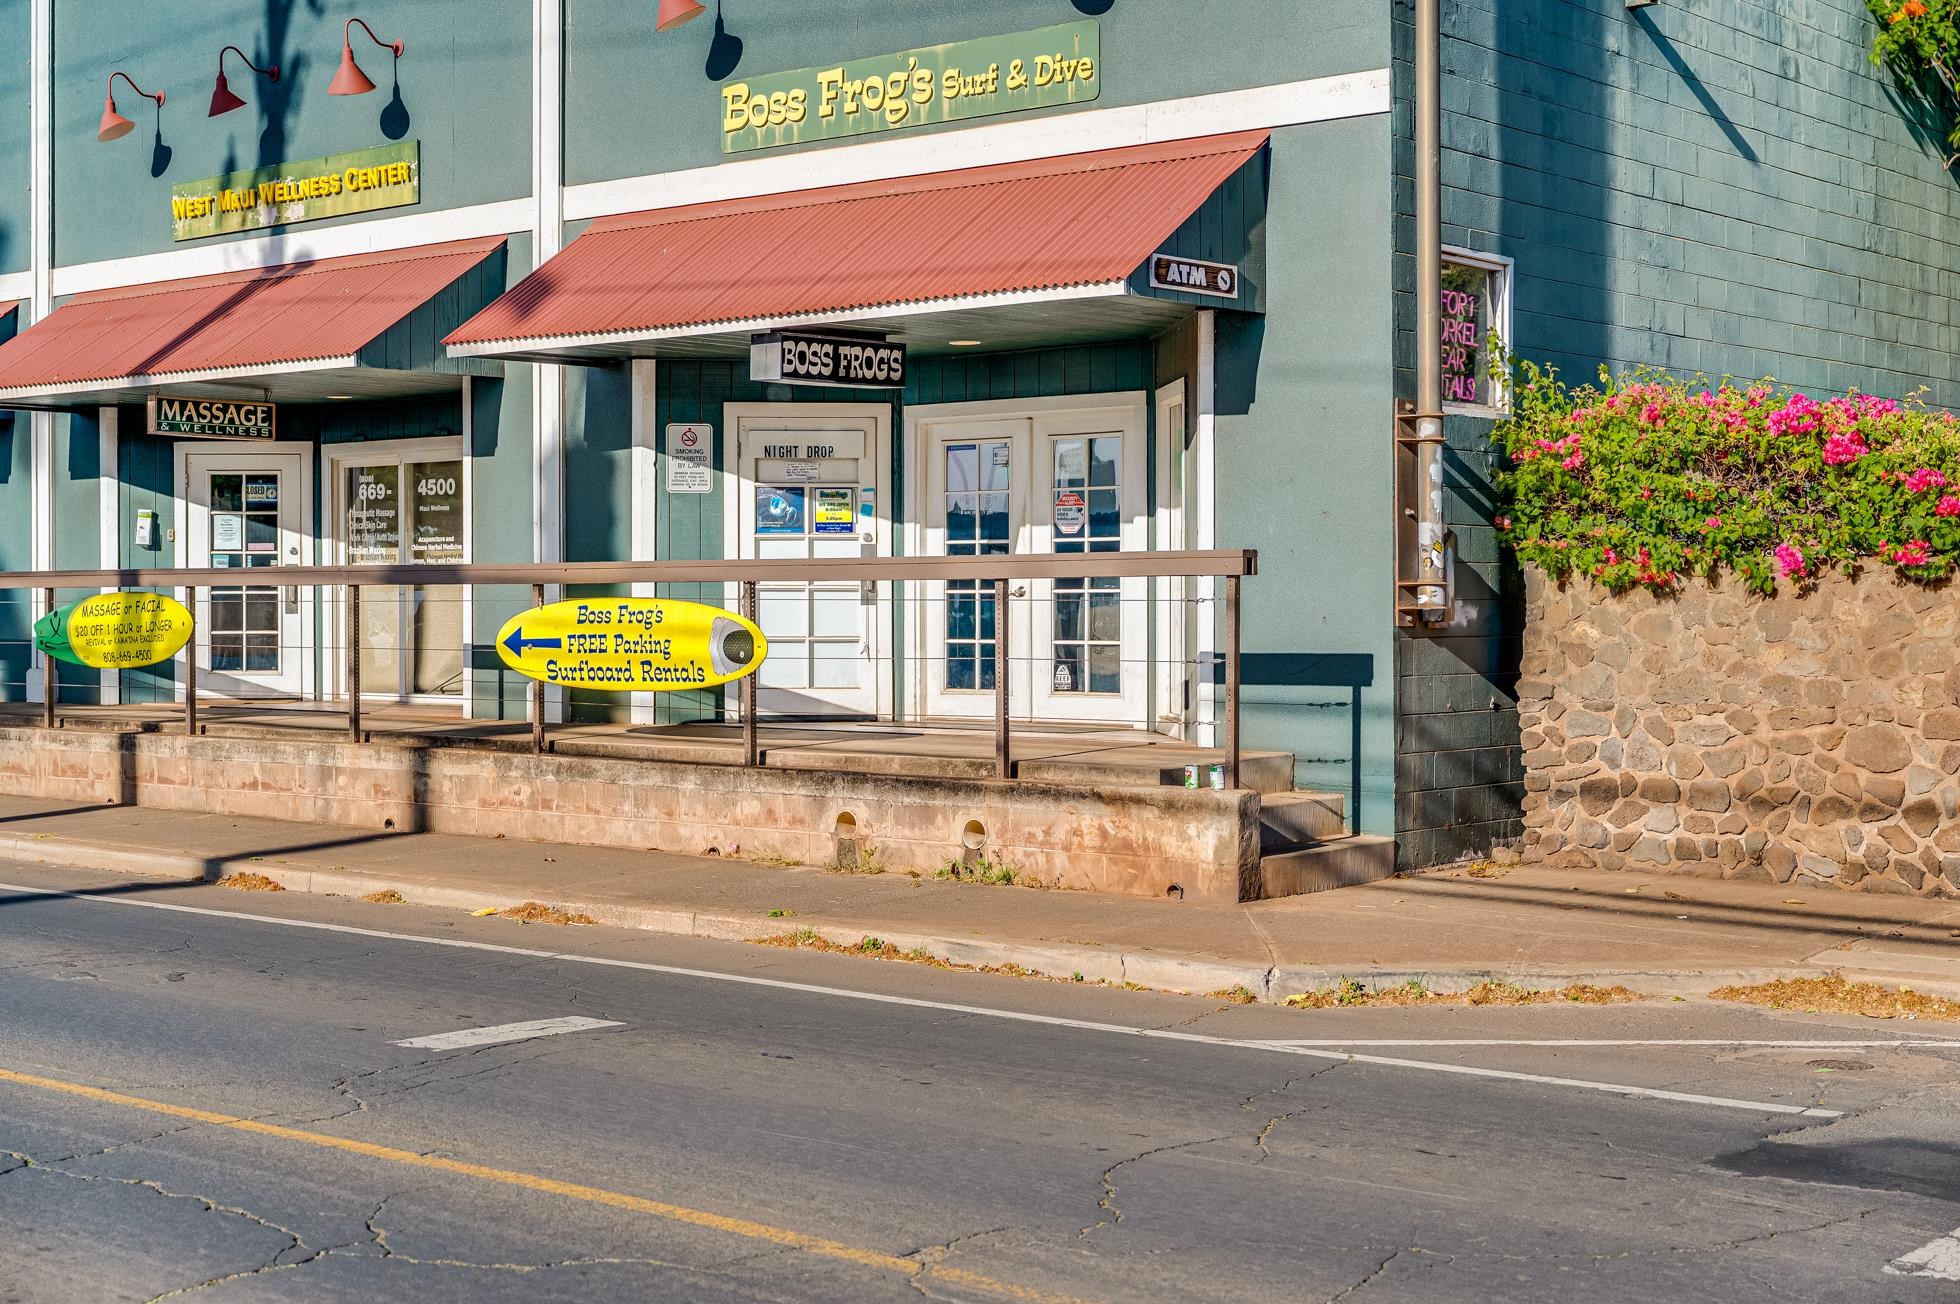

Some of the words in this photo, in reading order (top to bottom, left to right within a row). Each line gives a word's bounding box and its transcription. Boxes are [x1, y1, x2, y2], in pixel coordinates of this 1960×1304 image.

[723, 82, 807, 133] Boss
[817, 56, 934, 124] Frog's
[942, 62, 1000, 99] Surf
[1006, 58, 1028, 89] &
[1034, 53, 1093, 87] Dive
[171, 196, 214, 220] WEST
[218, 189, 257, 213] MAUI
[259, 173, 342, 204] WELLNESS
[345, 161, 411, 191] CENTER
[1166, 263, 1207, 286] ATM
[782, 340, 833, 376] BOSS
[838, 345, 902, 381] FROG'S
[160, 400, 269, 427] MASSAGE
[160, 422, 170, 431] &
[180, 423, 269, 437] WELLNESS
[764, 445, 799, 458] NIGHT
[807, 445, 834, 458] DROP
[417, 478, 456, 496] 4500
[81, 601, 121, 617] MASSAGE
[124, 604, 132, 614] or
[135, 599, 166, 614] FACIAL
[576, 605, 611, 625] Boss
[617, 603, 663, 630] Frog's
[75, 624, 88, 638] $20
[90, 624, 103, 636] OFF
[107, 623, 111, 635] 1
[113, 622, 133, 634] HOUR
[135, 625, 143, 633] or
[145, 619, 173, 632] LONGER
[102, 648, 152, 663] 808-669-4500
[567, 633, 608, 654] FREE
[613, 633, 671, 660] Parking
[546, 659, 635, 683] Surfboard
[640, 660, 705, 683] Rentals
